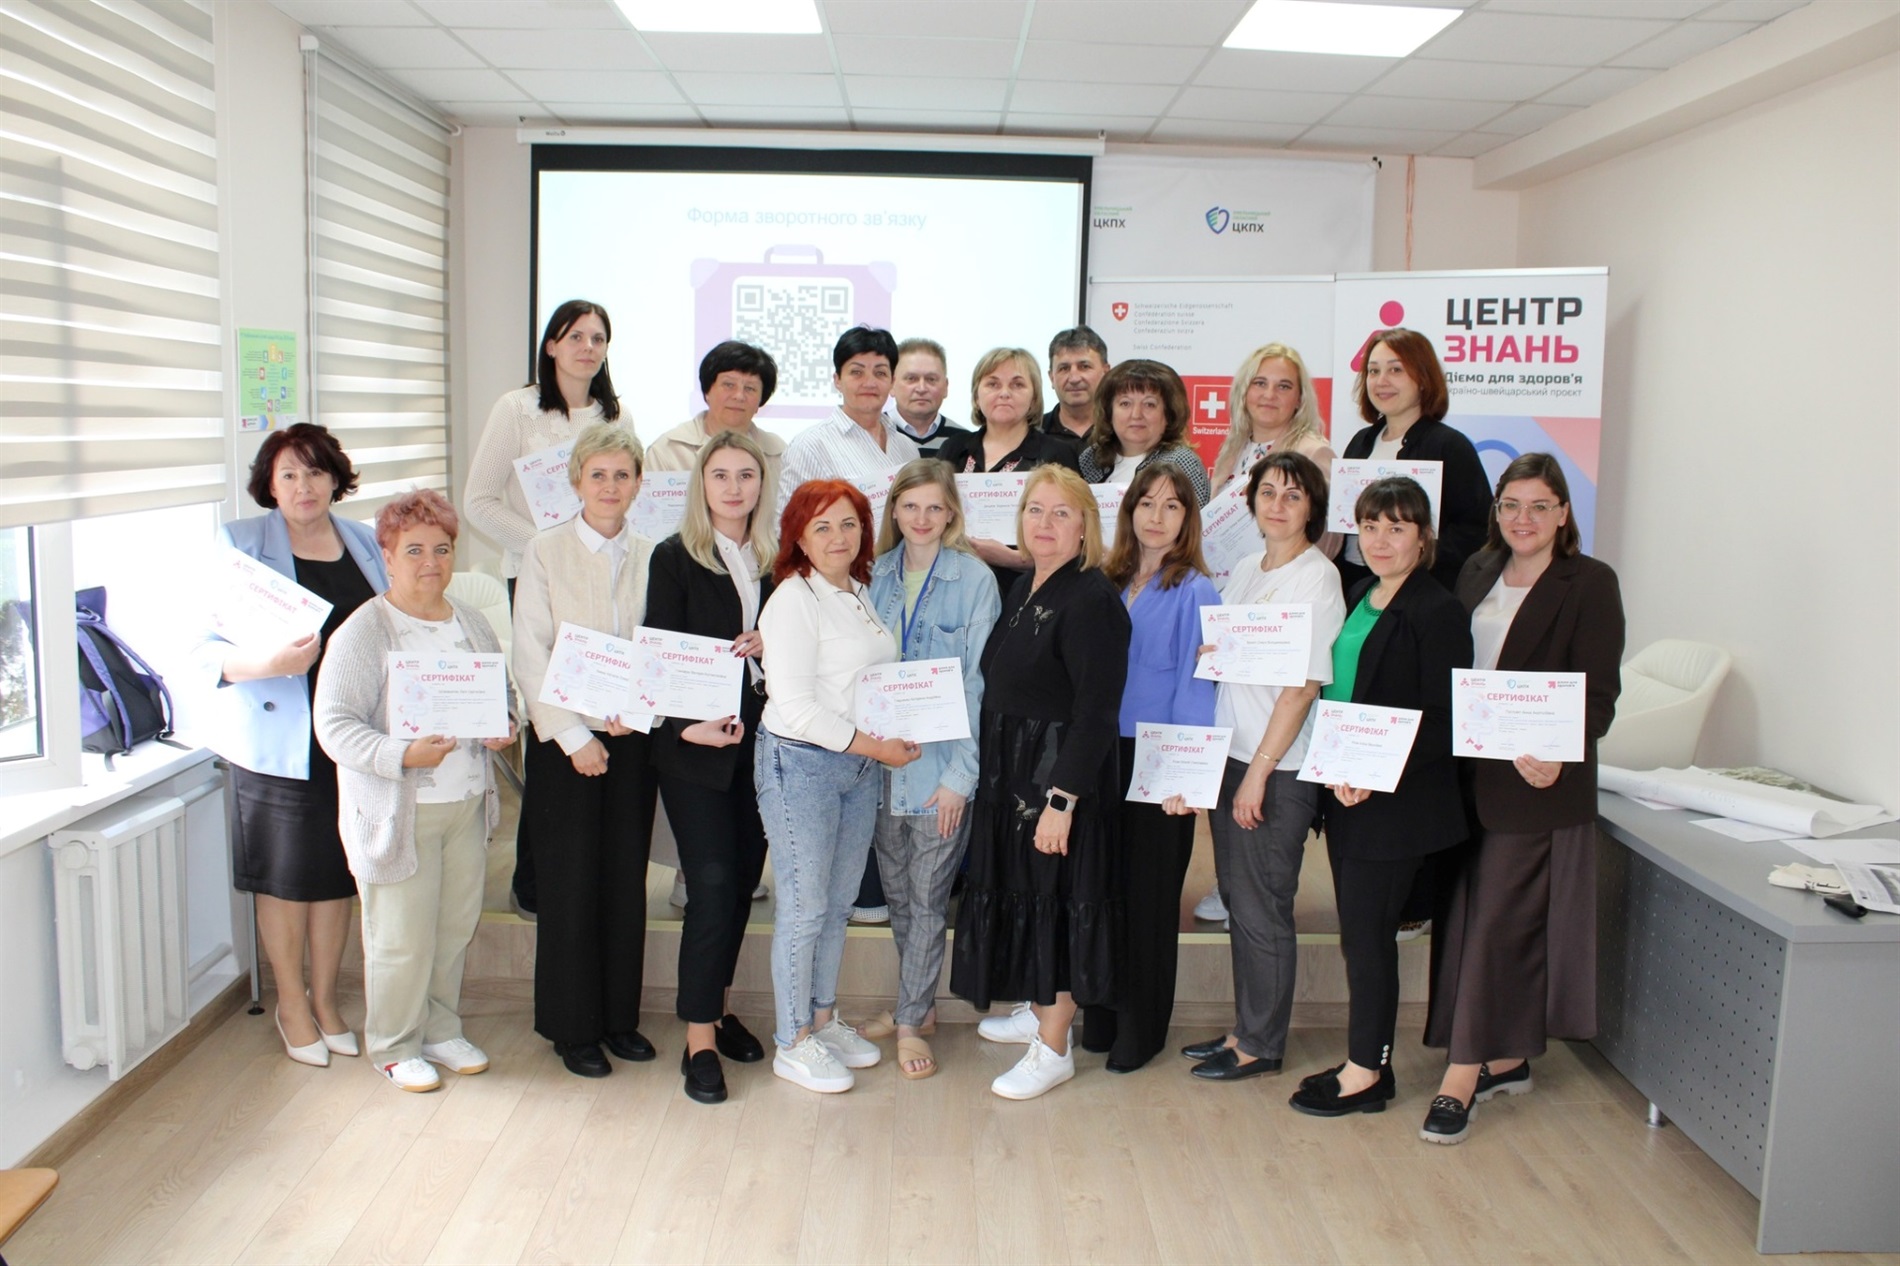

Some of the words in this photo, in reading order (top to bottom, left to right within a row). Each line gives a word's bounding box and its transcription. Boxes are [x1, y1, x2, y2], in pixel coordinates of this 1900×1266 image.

[687, 207, 749, 226] Форма
[755, 210, 857, 227] зворотного
[1093, 218, 1126, 229] ЦКПХ
[1232, 222, 1264, 233] ЦКПХ
[1446, 297, 1583, 330] ЦЕНТР
[1443, 335, 1579, 363] ЗНАНЬ
[1445, 371, 1484, 383] Діємо
[1488, 373, 1514, 385] для
[1448, 386, 1548, 397] країно-швейцарський
[546, 462, 568, 474] СЕРТИ
[969, 490, 1018, 499] СЕРТИФІКАТ
[1201, 503, 1239, 537] СЕРТИФІКАТ
[248, 582, 298, 614] СЕРТИФІКАТ
[1231, 625, 1283, 633] СЕРТИФІКАТ
[584, 650, 631, 669] СЕРТИФІК
[661, 651, 715, 665] СЕРТИФІКАТ
[421, 674, 475, 682] СЕРТИФІКАТ
[883, 680, 934, 692] СЕРТИФІКАТ
[1486, 692, 1549, 703] СЕРТИФІКАТ
[1340, 724, 1389, 736] СЕРТИФІКАТ
[1161, 744, 1205, 754] СЕРТИФІКАТ
